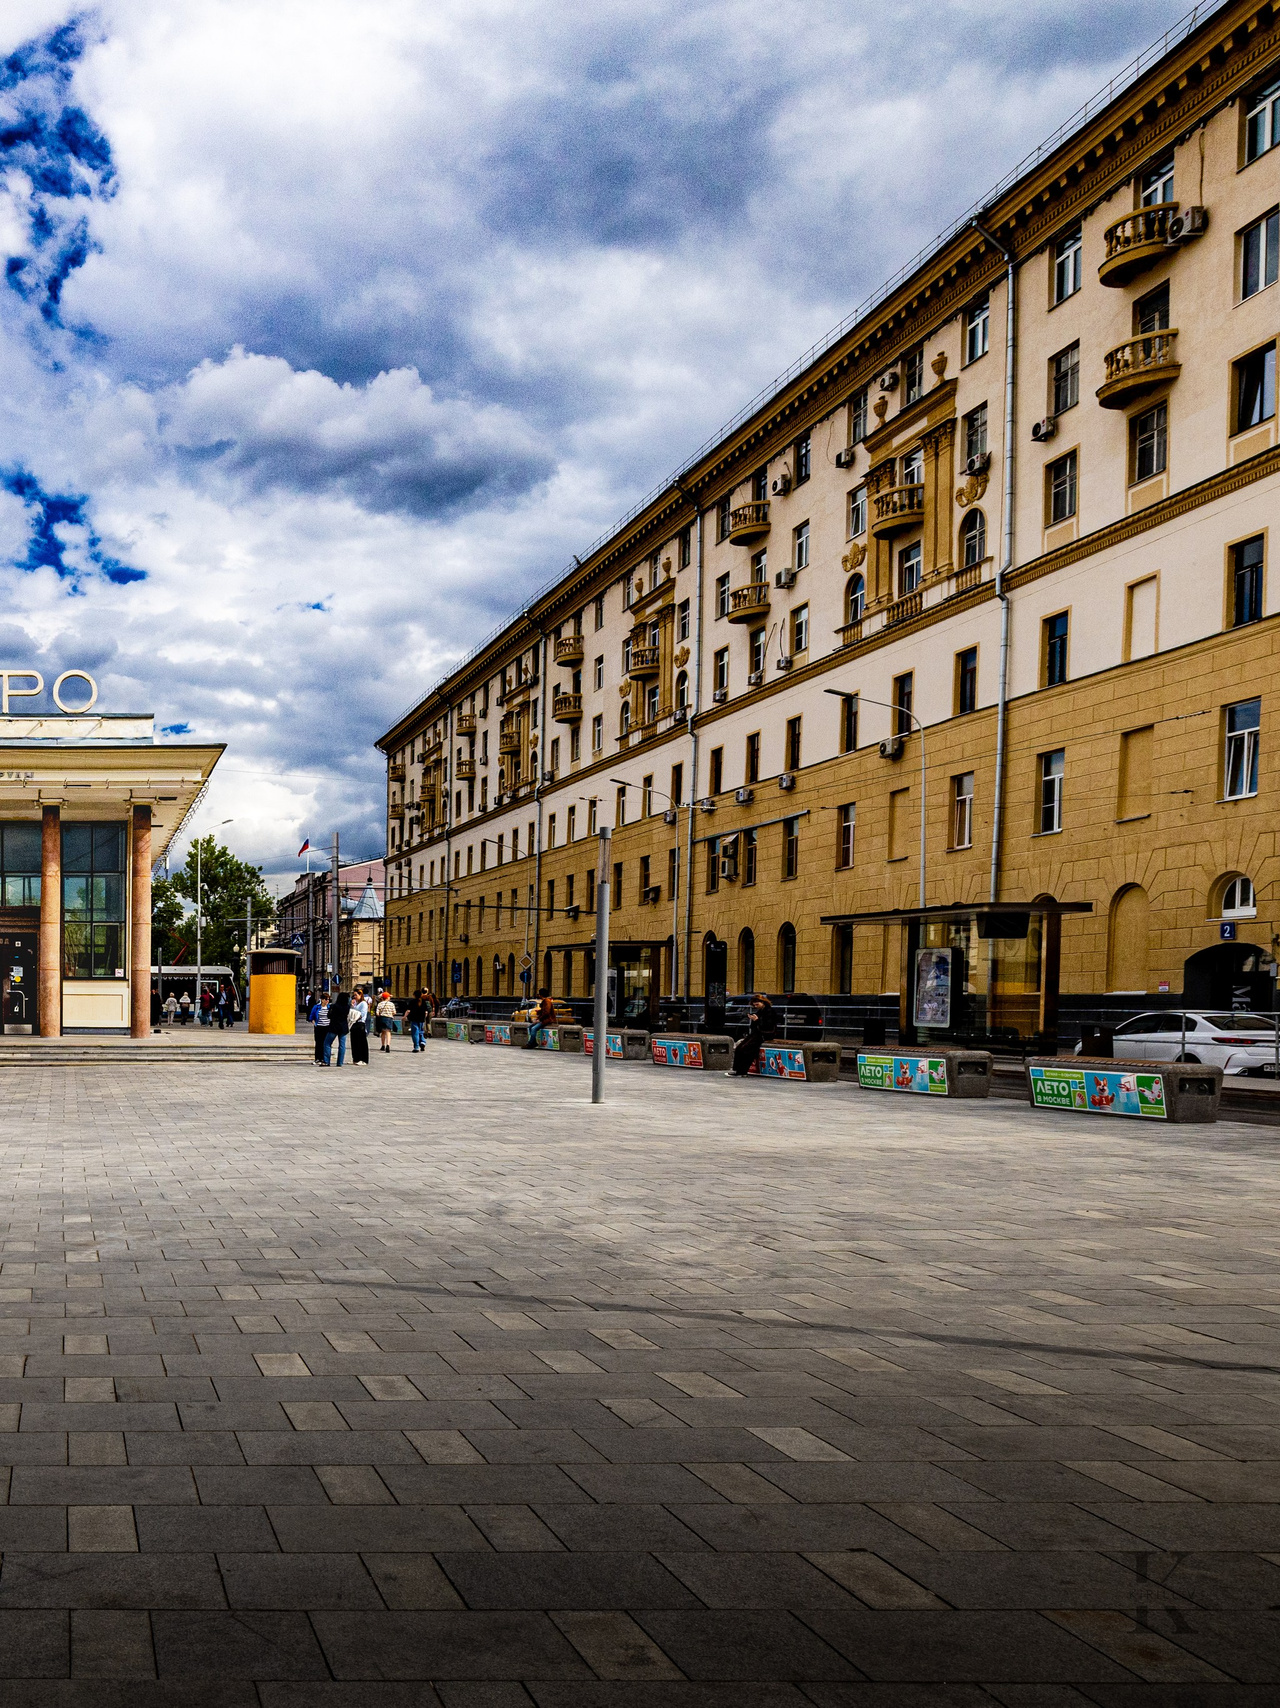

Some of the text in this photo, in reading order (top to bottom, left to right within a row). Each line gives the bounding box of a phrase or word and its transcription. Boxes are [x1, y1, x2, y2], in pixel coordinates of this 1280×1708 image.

[860, 1065, 882, 1077] ЛЕТО
[1036, 1080, 1069, 1096] ЛЕТО
[1043, 1096, 1070, 1105] МОСКВЕ
